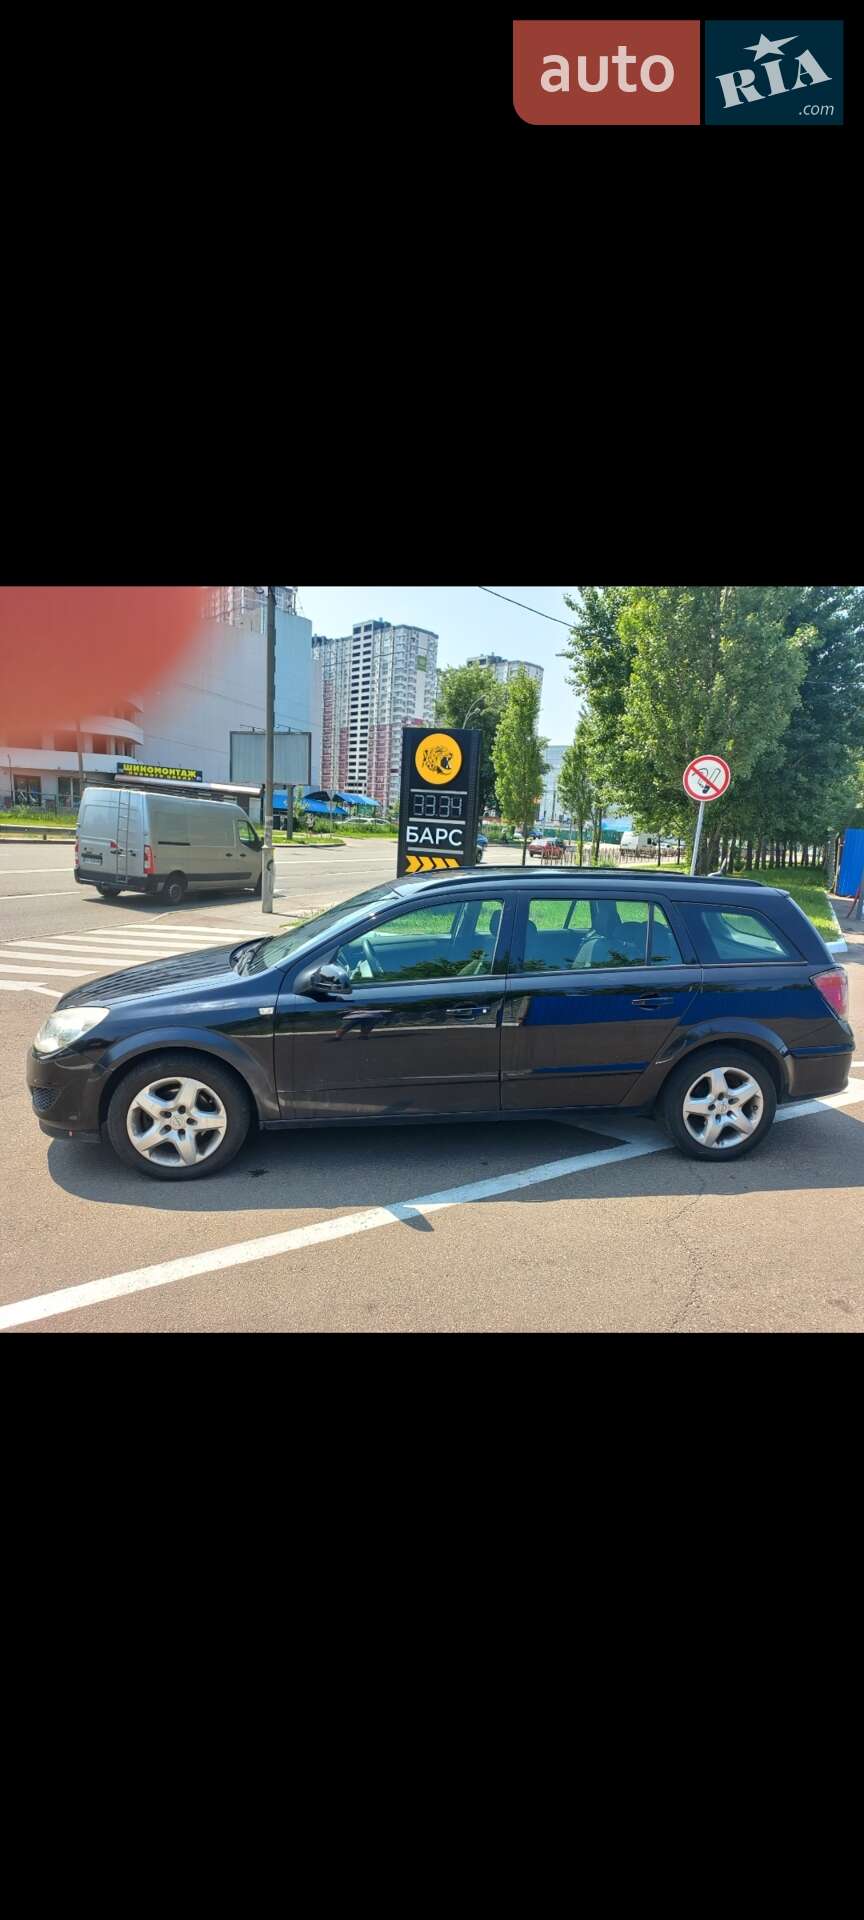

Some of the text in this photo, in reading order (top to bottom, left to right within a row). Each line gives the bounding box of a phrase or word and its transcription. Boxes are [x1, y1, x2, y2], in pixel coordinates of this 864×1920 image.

[123, 763, 197, 778] ШИНОМОНТАЖ
[413, 794, 463, 818] 33.34
[406, 825, 463, 846] БАРС
